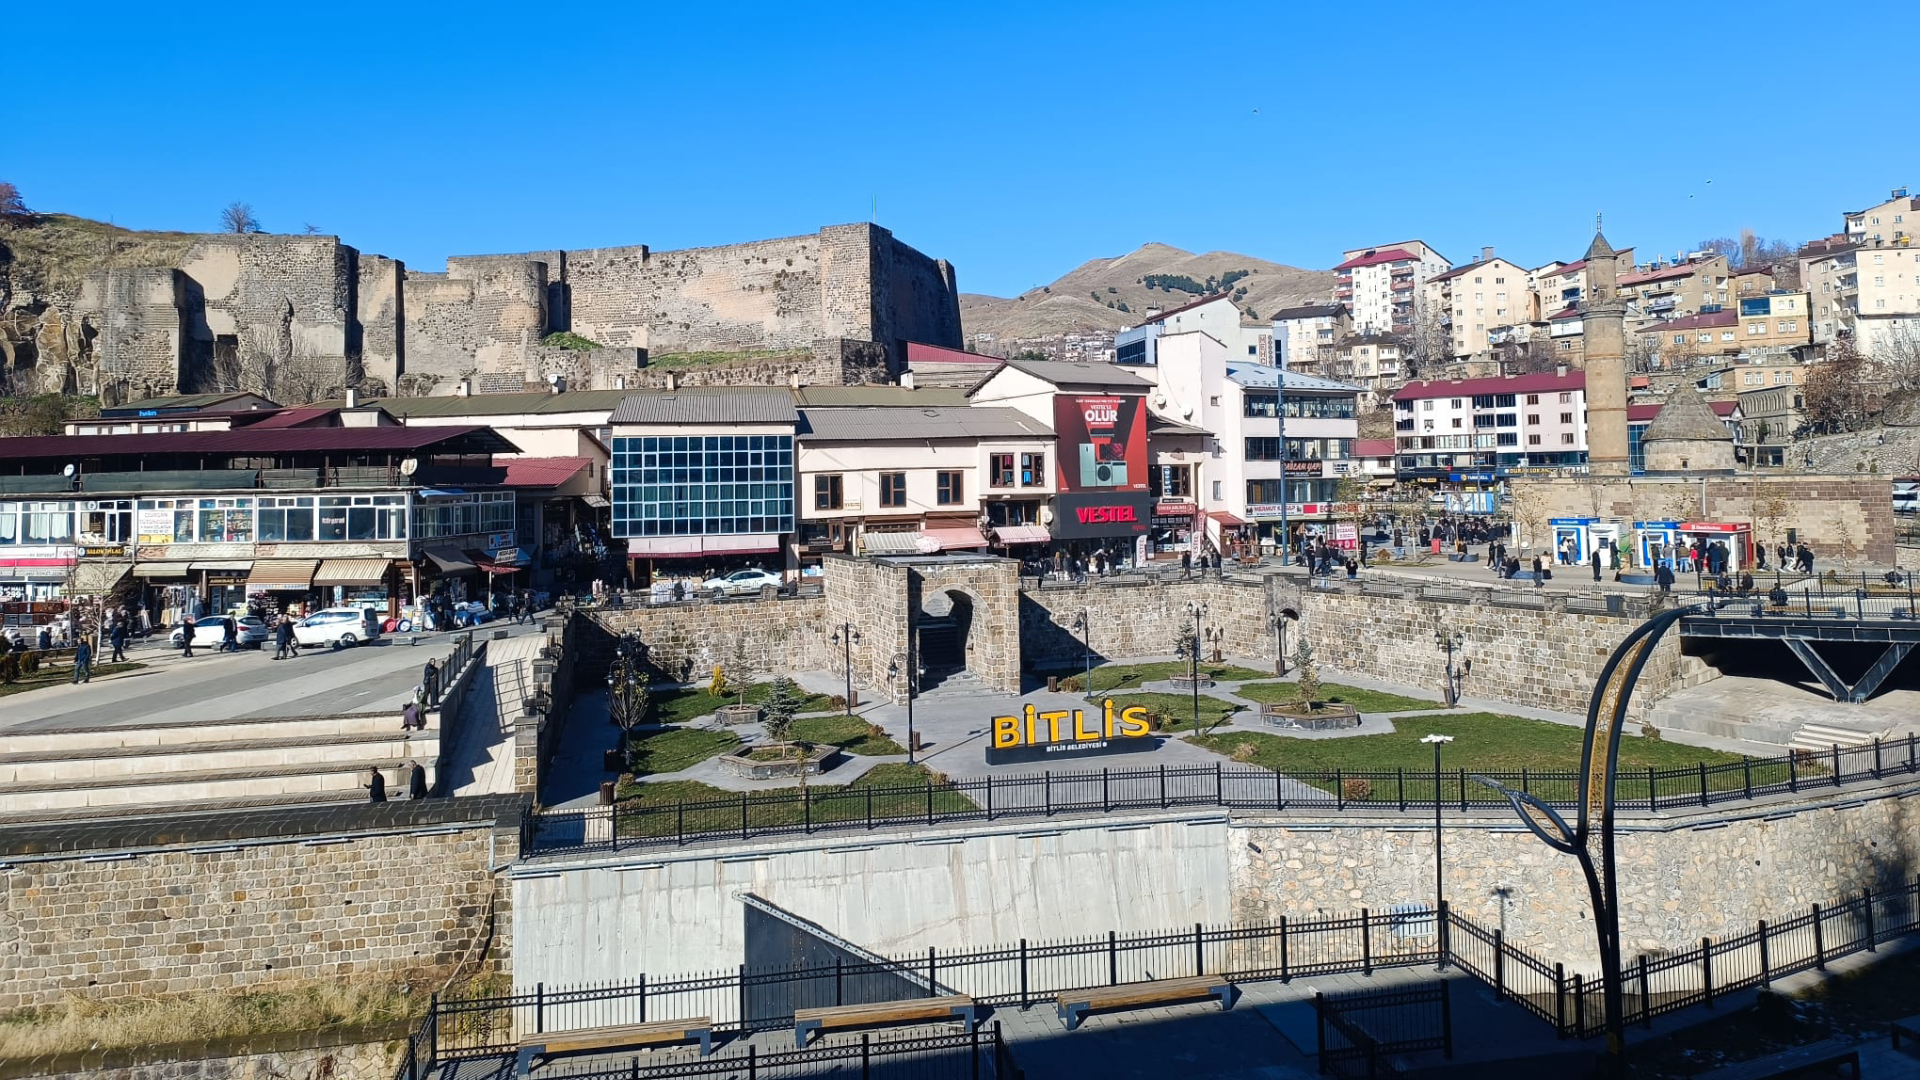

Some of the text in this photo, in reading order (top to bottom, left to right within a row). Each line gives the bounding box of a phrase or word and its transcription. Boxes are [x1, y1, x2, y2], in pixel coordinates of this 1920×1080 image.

[1084, 409, 1118, 422] OLUR
[1076, 506, 1139, 524] VESTEL
[991, 699, 1150, 749] BİTLİS
[1045, 742, 1101, 753] BİTLİS BELEDİYESİ
